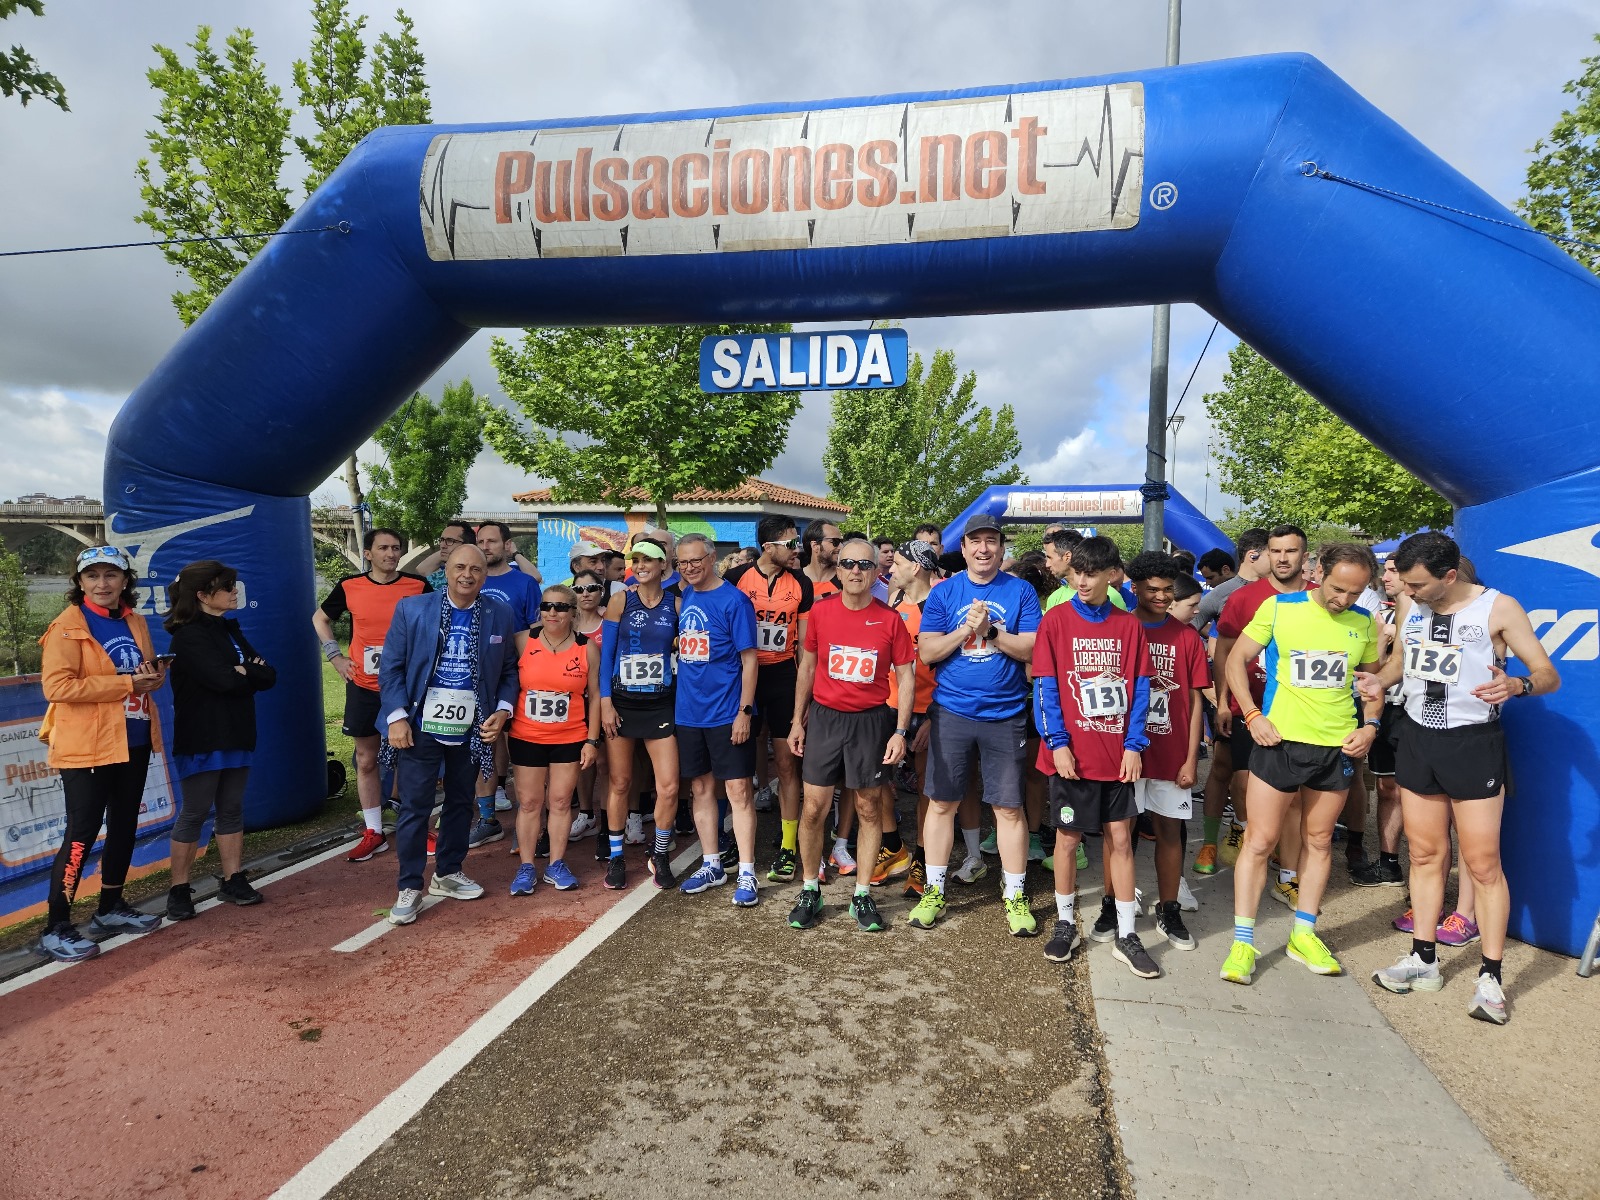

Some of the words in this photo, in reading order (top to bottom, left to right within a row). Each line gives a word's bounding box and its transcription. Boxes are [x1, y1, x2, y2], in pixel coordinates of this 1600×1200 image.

[494, 115, 1048, 226] Pulsaciones.net
[711, 333, 893, 388] SALIDA
[1022, 496, 1126, 512] Pulsaciones.net
[680, 636, 709, 656] 293
[763, 628, 786, 646] 16
[1072, 637, 1115, 651] APRENDE
[1116, 639, 1122, 652] A
[1073, 651, 1121, 667] LIBERARTE
[1147, 642, 1169, 656] NDE
[1170, 645, 1176, 658] A
[371, 652, 382, 670] 9
[623, 660, 663, 680] 132
[830, 653, 874, 678] 278
[1295, 658, 1346, 682] 124
[1411, 647, 1457, 676] 136
[125, 694, 149, 714] 50
[529, 697, 568, 717] 138
[1086, 686, 1124, 710] 131
[1149, 697, 1167, 718] 4
[432, 703, 467, 721] 250
[0, 728, 40, 743] GANIZAC
